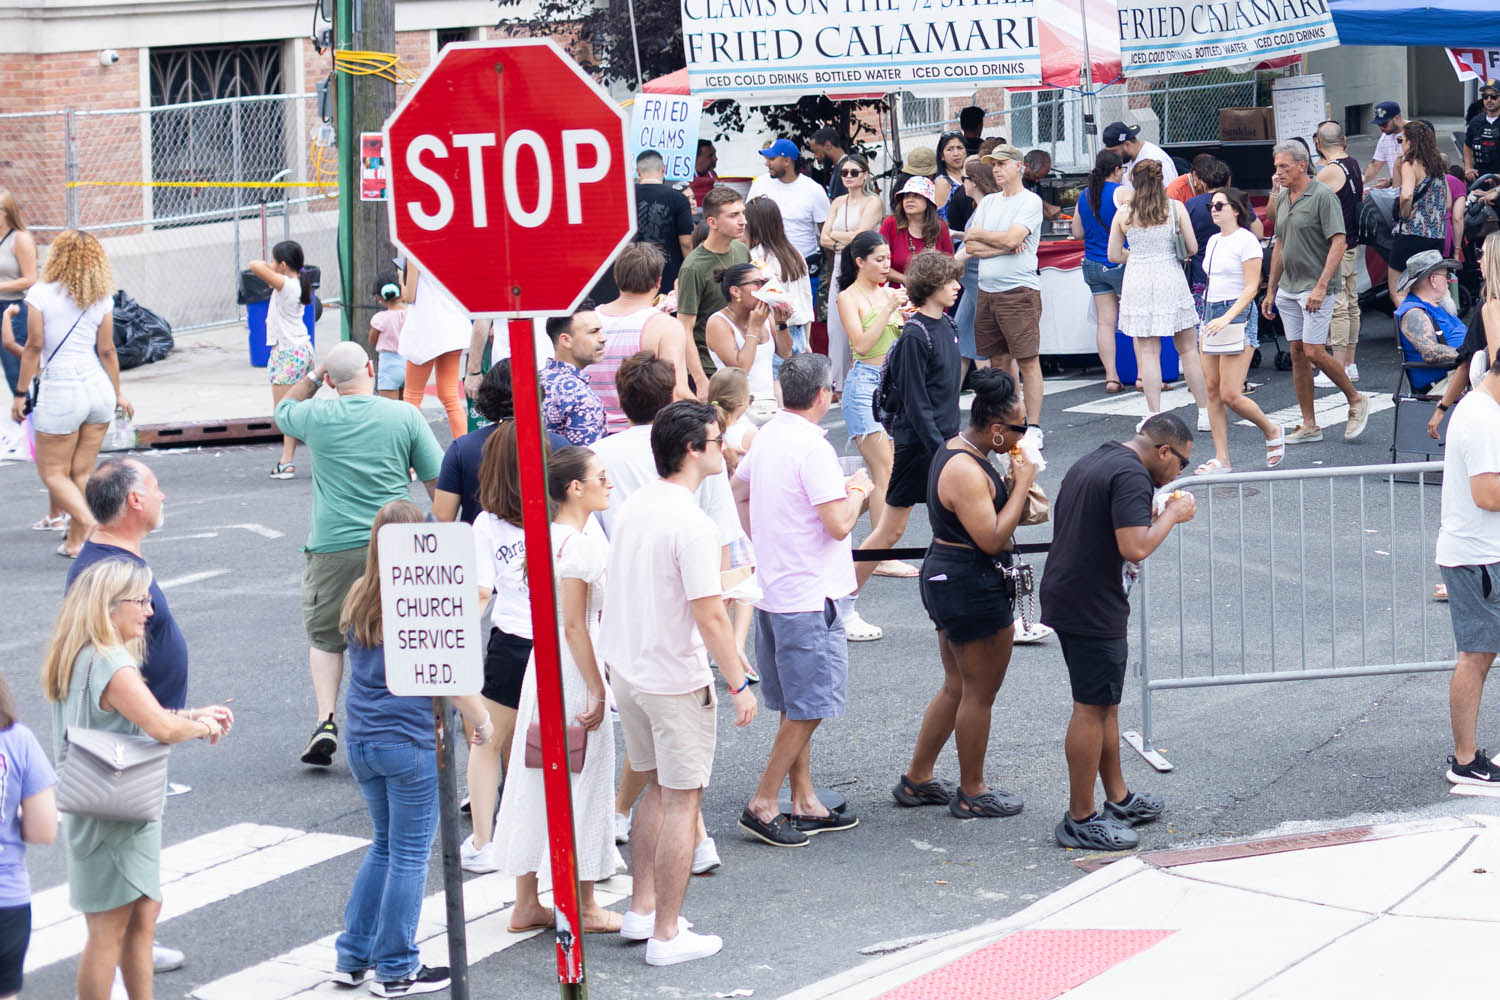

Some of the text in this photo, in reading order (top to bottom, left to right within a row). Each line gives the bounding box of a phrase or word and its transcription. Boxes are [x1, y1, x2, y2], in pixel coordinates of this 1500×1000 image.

[1118, 5, 1186, 41] FRIED
[686, 16, 1038, 64] FRIED CALAMARI
[1131, 27, 1326, 65] ICED COLD DRINKS BOTTLED WATER ICED COLD DRINKS
[706, 62, 1025, 88] ICED COLD DRINKS BOTTLED WATER ICED COLD DRINKS
[643, 100, 689, 122] FRIED
[640, 127, 685, 149] CLAMS
[406, 129, 612, 231] STOP
[414, 533, 438, 553] NO
[392, 565, 464, 586] PARKING
[396, 597, 464, 618] CHURCH
[398, 629, 465, 649] SERVICE
